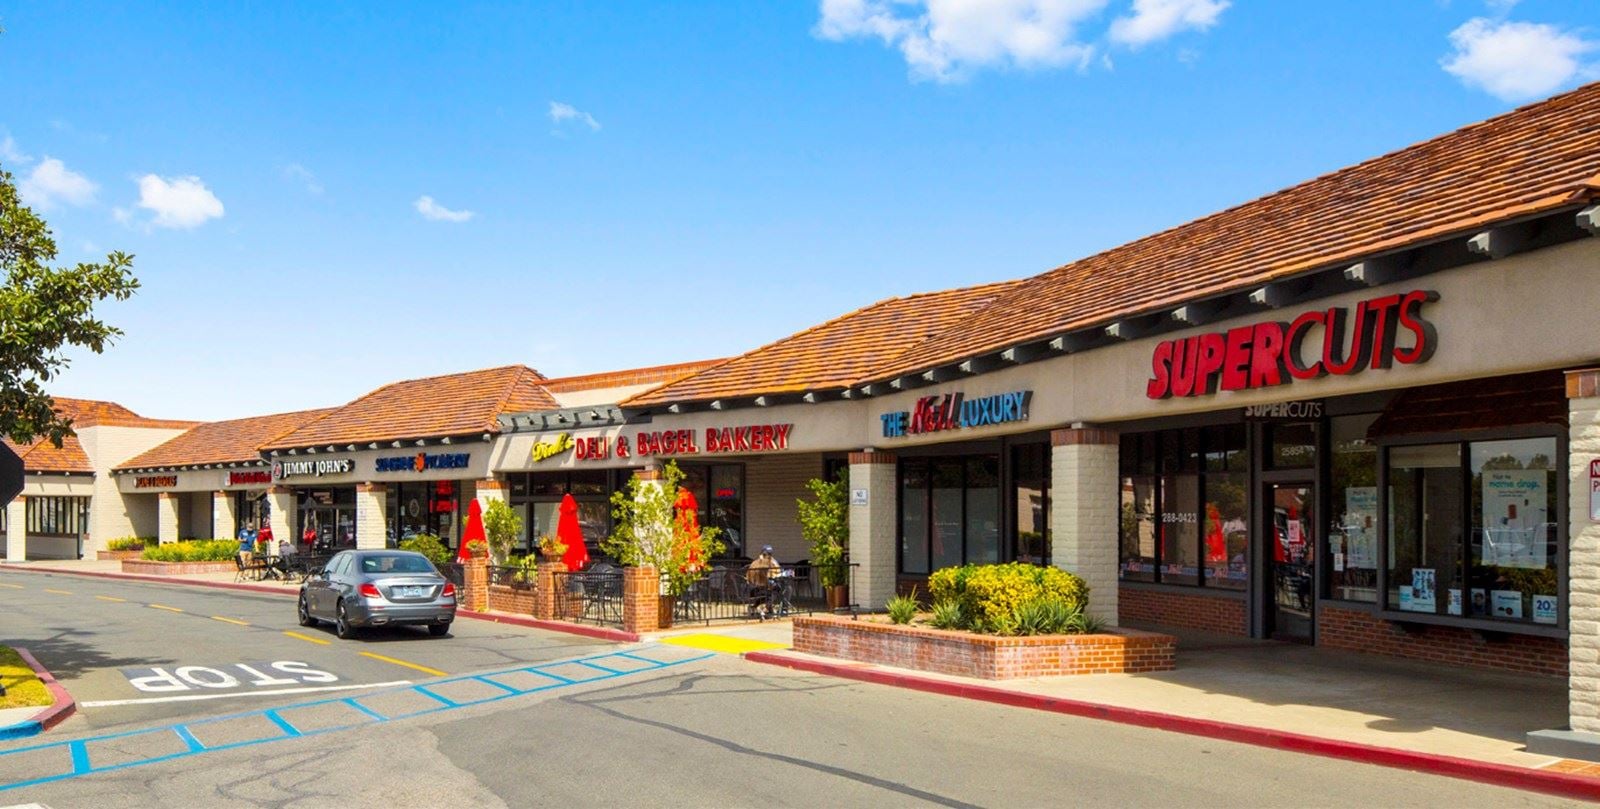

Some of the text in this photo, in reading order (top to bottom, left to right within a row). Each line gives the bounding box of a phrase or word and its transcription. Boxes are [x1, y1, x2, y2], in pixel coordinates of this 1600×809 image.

[1146, 289, 1438, 400] SUPERCUTS
[880, 411, 906, 438] THE
[908, 392, 961, 435] Nail
[1245, 401, 1322, 418] SUPERCUTS
[575, 436, 609, 461] DELI
[616, 435, 630, 458] &
[636, 428, 699, 455] BAGEL
[705, 423, 792, 452] BAKERY
[283, 461, 315, 478] JIMMY
[315, 458, 350, 477] JOHN'S
[128, 660, 339, 692] STOP
